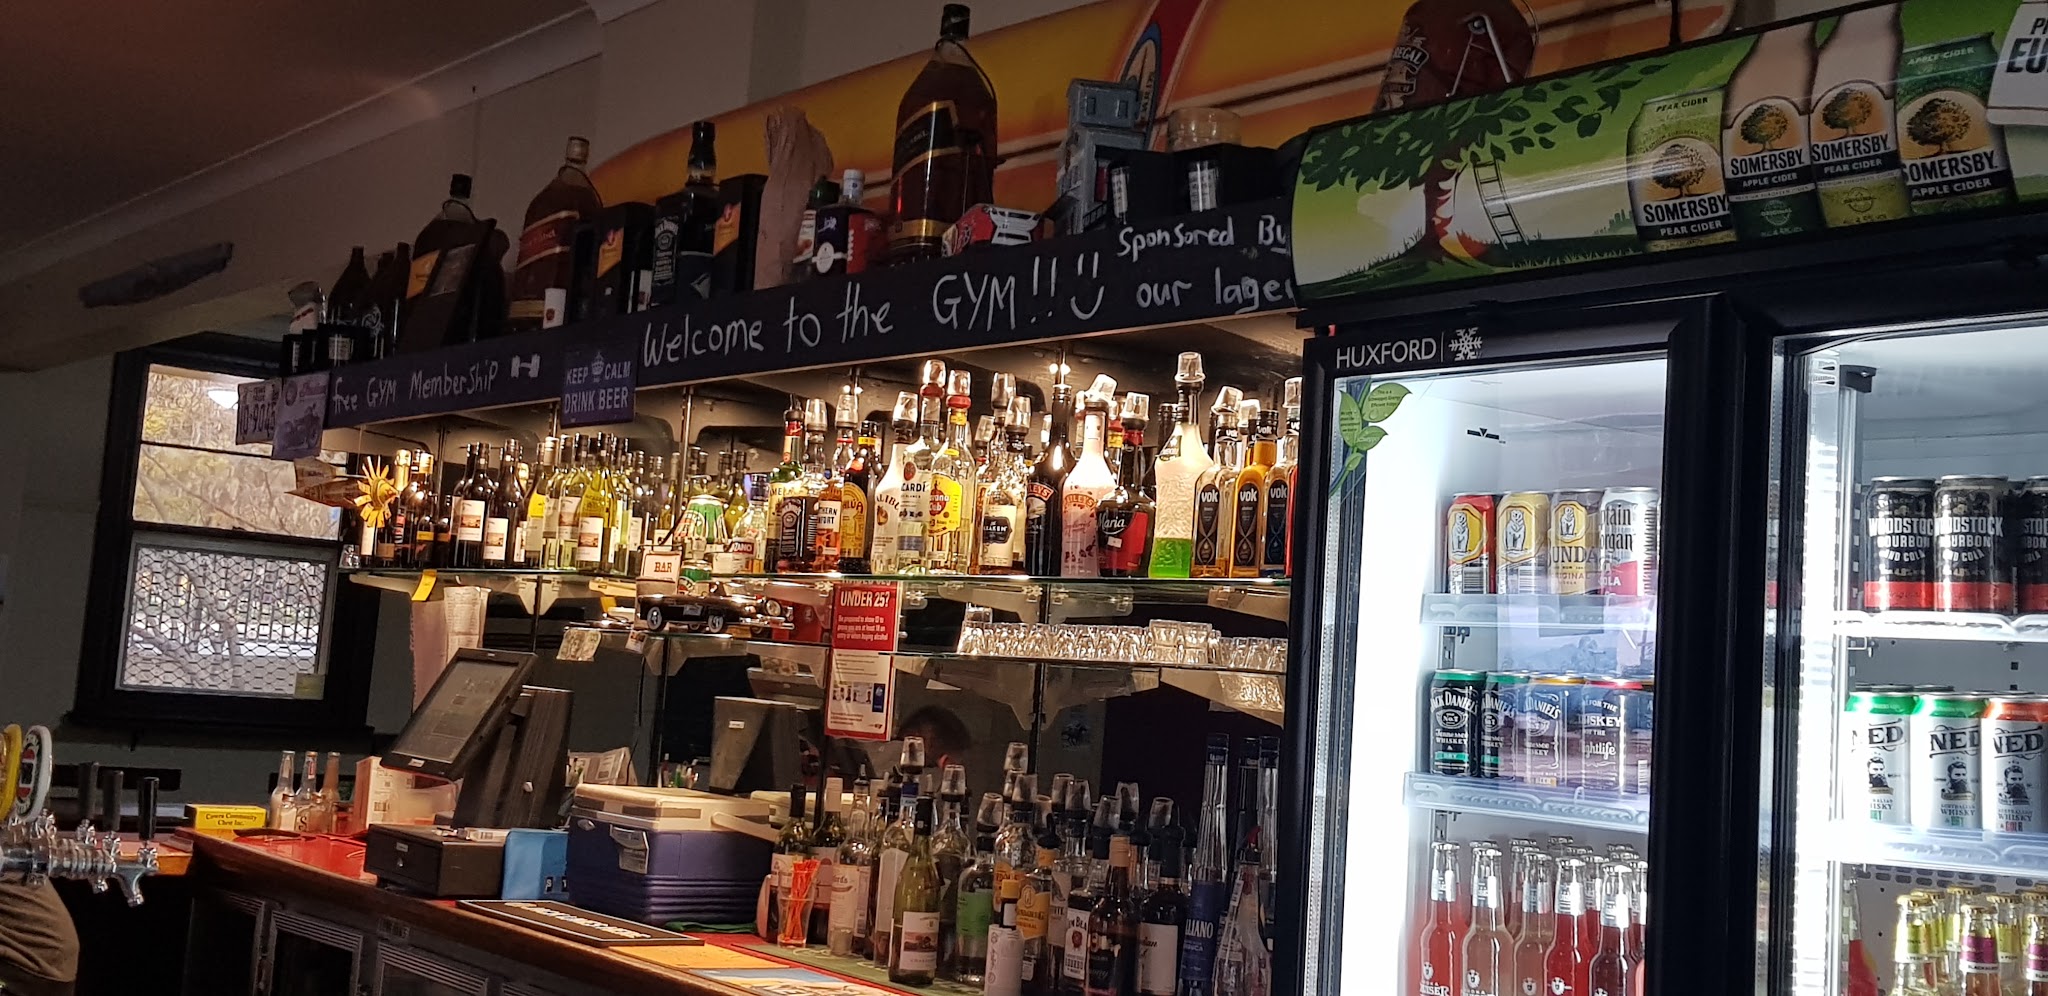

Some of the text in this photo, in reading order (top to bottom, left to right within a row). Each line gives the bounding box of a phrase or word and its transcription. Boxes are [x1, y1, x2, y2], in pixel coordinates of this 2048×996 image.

[1907, 46, 1975, 65] APPLE CIDER
[2006, 37, 2048, 73] EU
[1656, 97, 1708, 113] PEAR CIDER
[1811, 133, 1891, 162] SOMERSBY
[1731, 148, 1803, 176] SOMERSBY
[1824, 158, 1882, 174] PEAR CIDER
[1901, 150, 1997, 182] SOMERSBY
[1742, 172, 1798, 188] APPLE CIDER
[1911, 177, 1991, 198] APPLE CIDER
[1643, 195, 1727, 223] SOMERSBY
[1660, 225, 1687, 237] PEAR
[1690, 220, 1723, 233] CIDER
[1136, 281, 1192, 308] our
[643, 314, 764, 368] Welcome
[783, 297, 820, 353] to
[836, 282, 893, 344] the
[1336, 337, 1437, 369] HUXFORD
[566, 361, 631, 385] KEEP CALM
[366, 377, 397, 408] GYM
[564, 386, 629, 414] DRINK BEER
[1028, 485, 1049, 496] LEYS
[1935, 516, 2004, 538] ODSTOCK
[1939, 536, 1991, 548] URBON
[1903, 549, 1926, 562] COLA
[1962, 549, 1985, 562] COLA
[654, 561, 673, 573] BAR
[840, 591, 890, 608] UNDER 25?
[1603, 701, 1619, 713] THE
[1852, 726, 1904, 745] ED
[1076, 916, 1087, 931] BEA
